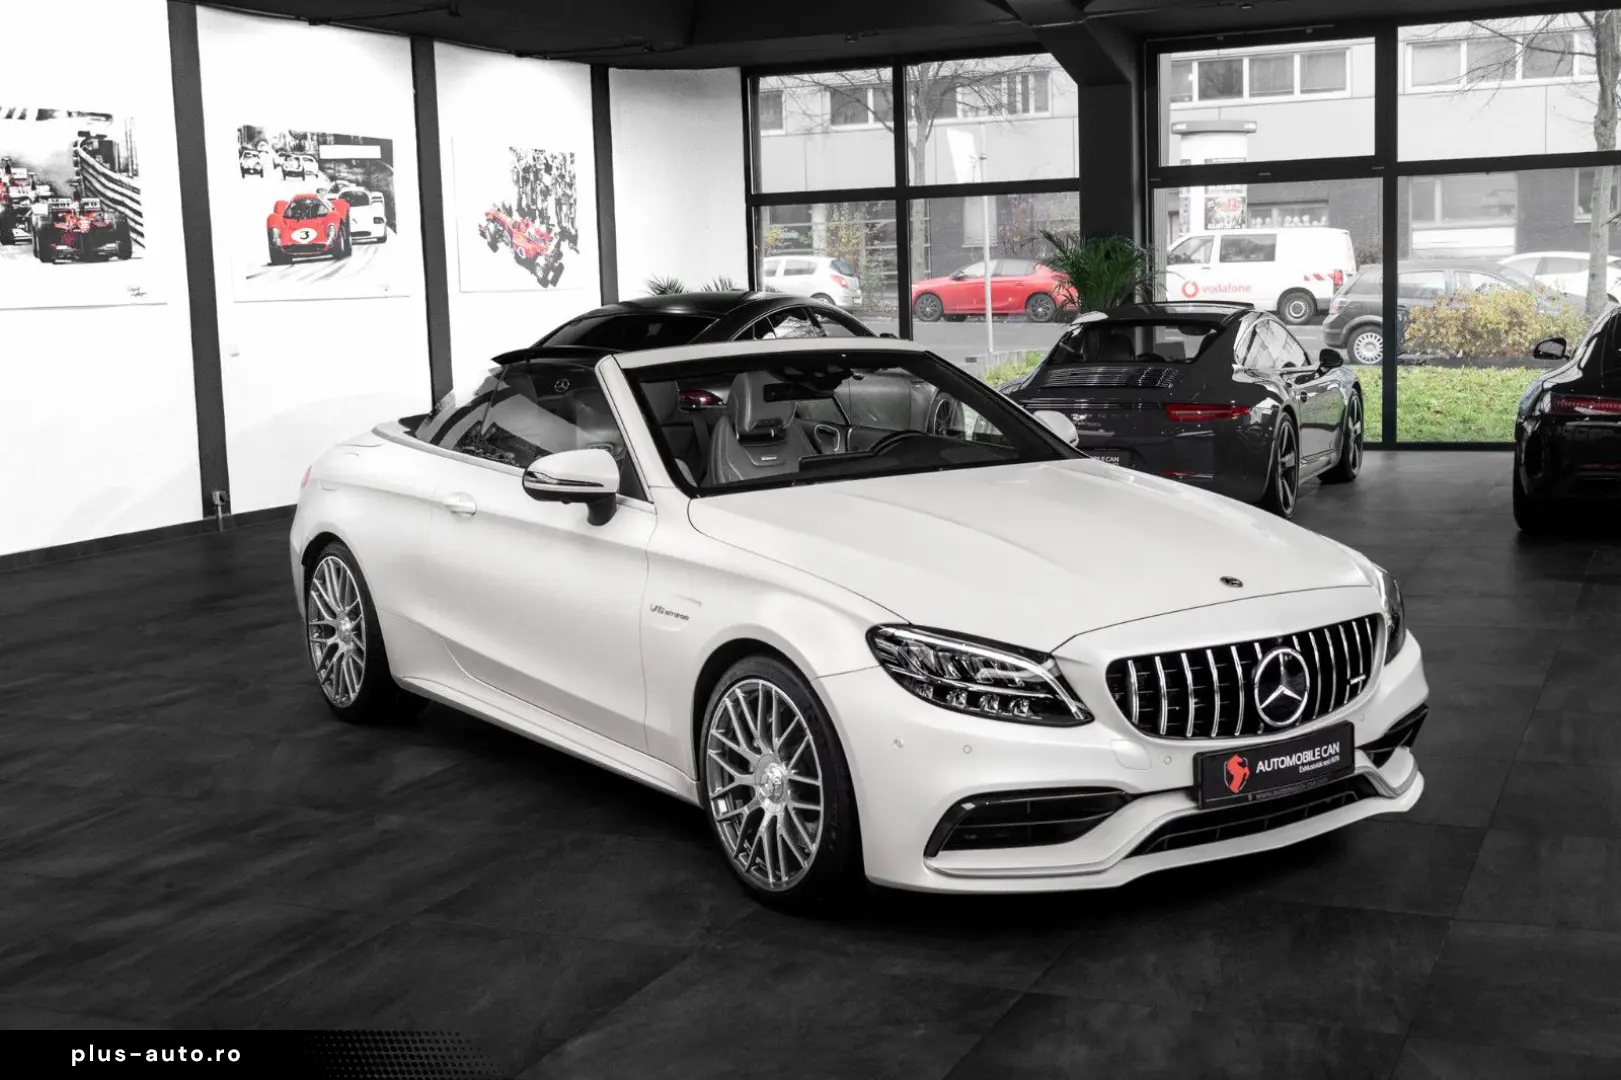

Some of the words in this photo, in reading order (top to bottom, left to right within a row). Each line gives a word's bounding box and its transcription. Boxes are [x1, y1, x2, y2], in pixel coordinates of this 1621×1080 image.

[300, 230, 310, 240] 3
[1202, 284, 1252, 294] vodafone
[1256, 748, 1321, 773] AUTOMOBILE
[1321, 741, 1340, 757] CAN
